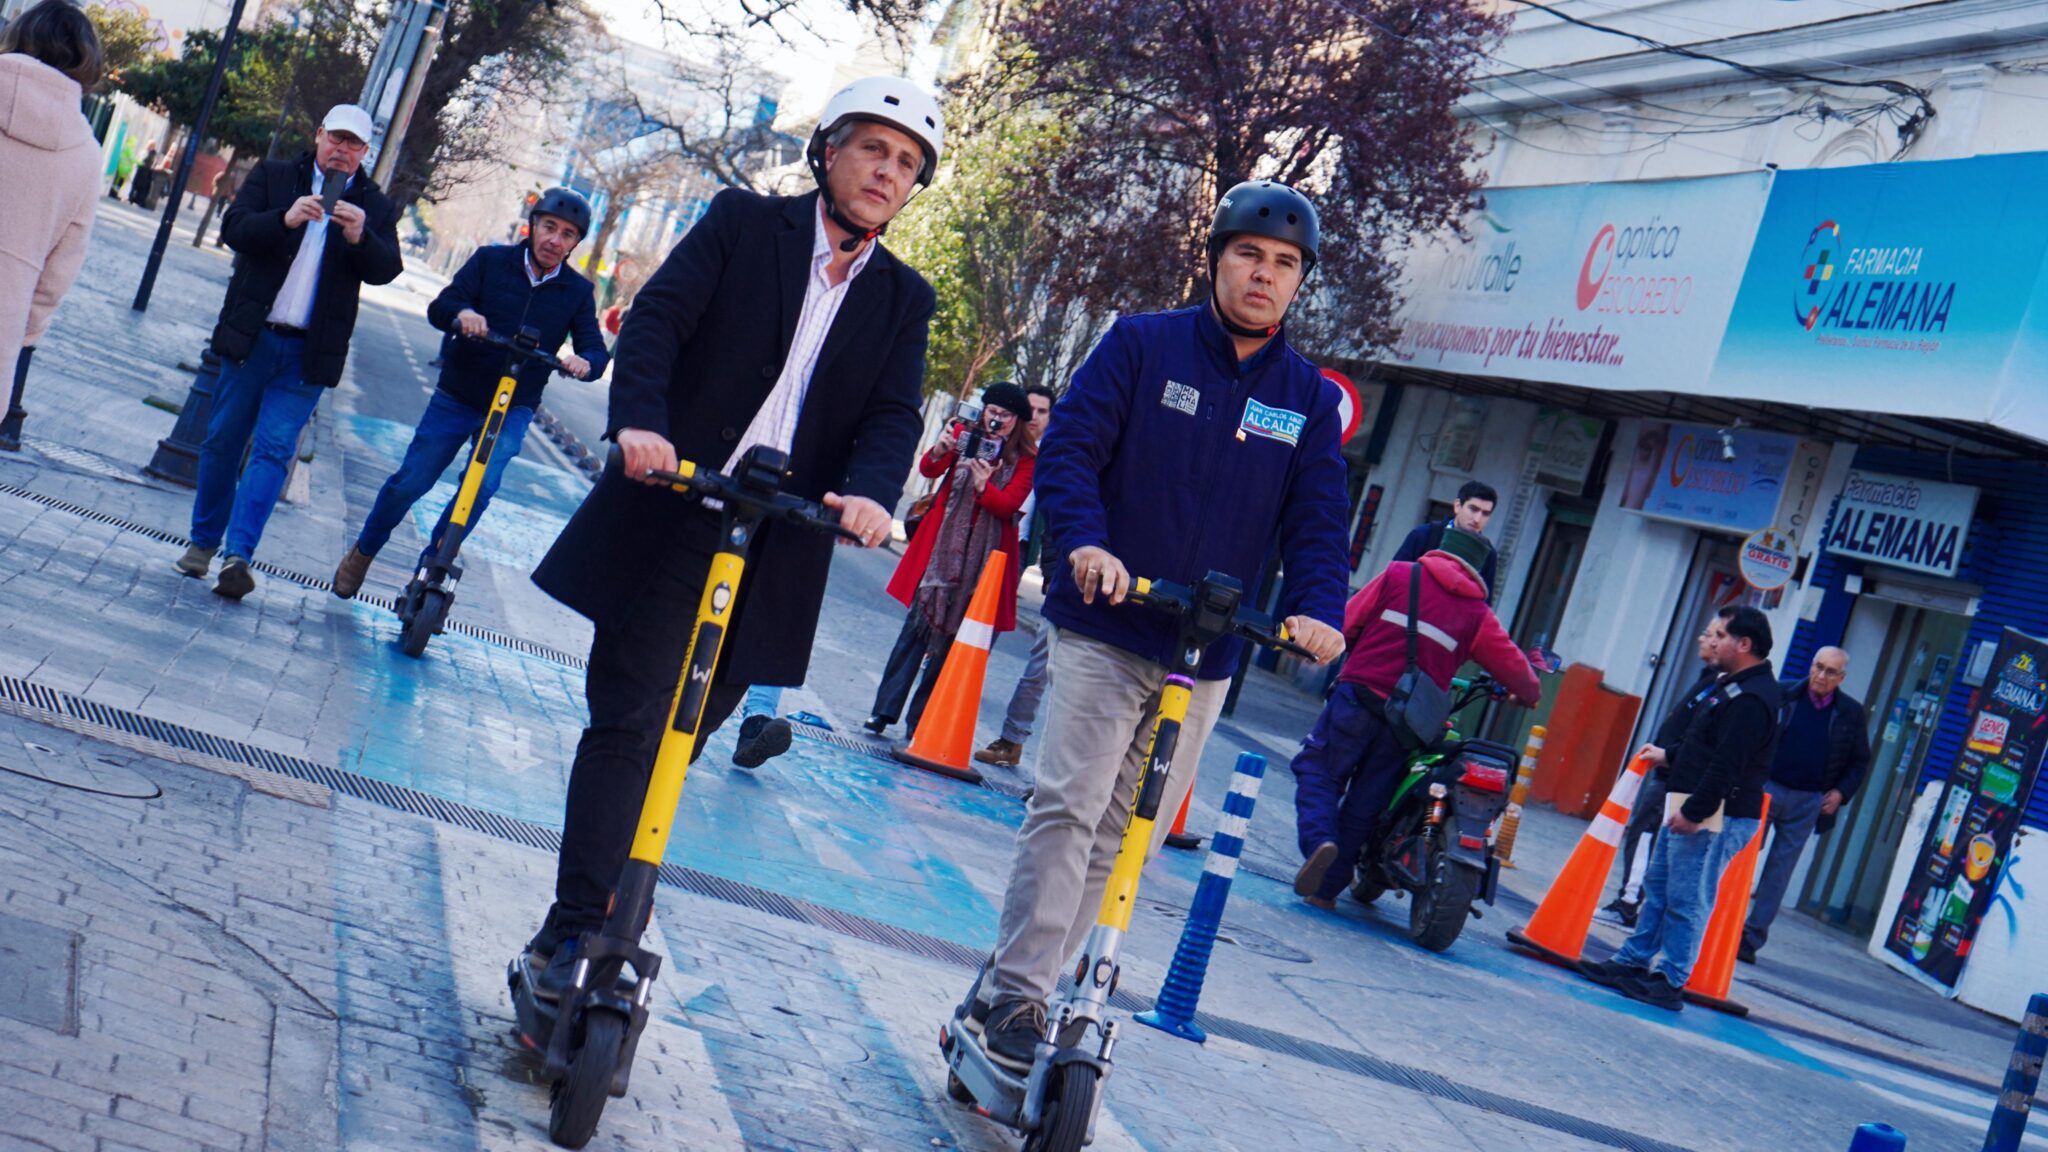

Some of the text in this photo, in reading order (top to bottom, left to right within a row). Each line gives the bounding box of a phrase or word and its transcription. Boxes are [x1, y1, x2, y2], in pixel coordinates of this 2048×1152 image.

[1616, 216, 1681, 269] optica
[1843, 247, 1924, 276] FARMACIA
[1598, 275, 1693, 315] ESCOBEDO
[1822, 281, 1957, 333] ALEMANA
[1482, 327, 1522, 369] por
[1516, 321, 1541, 359] tu
[1538, 316, 1625, 366] bienestar...
[1246, 411, 1301, 438] ALCALDE
[1842, 472, 1921, 511] Farmacia
[1828, 507, 1960, 571] ALEMANA
[1748, 549, 1790, 570] GRATIS
